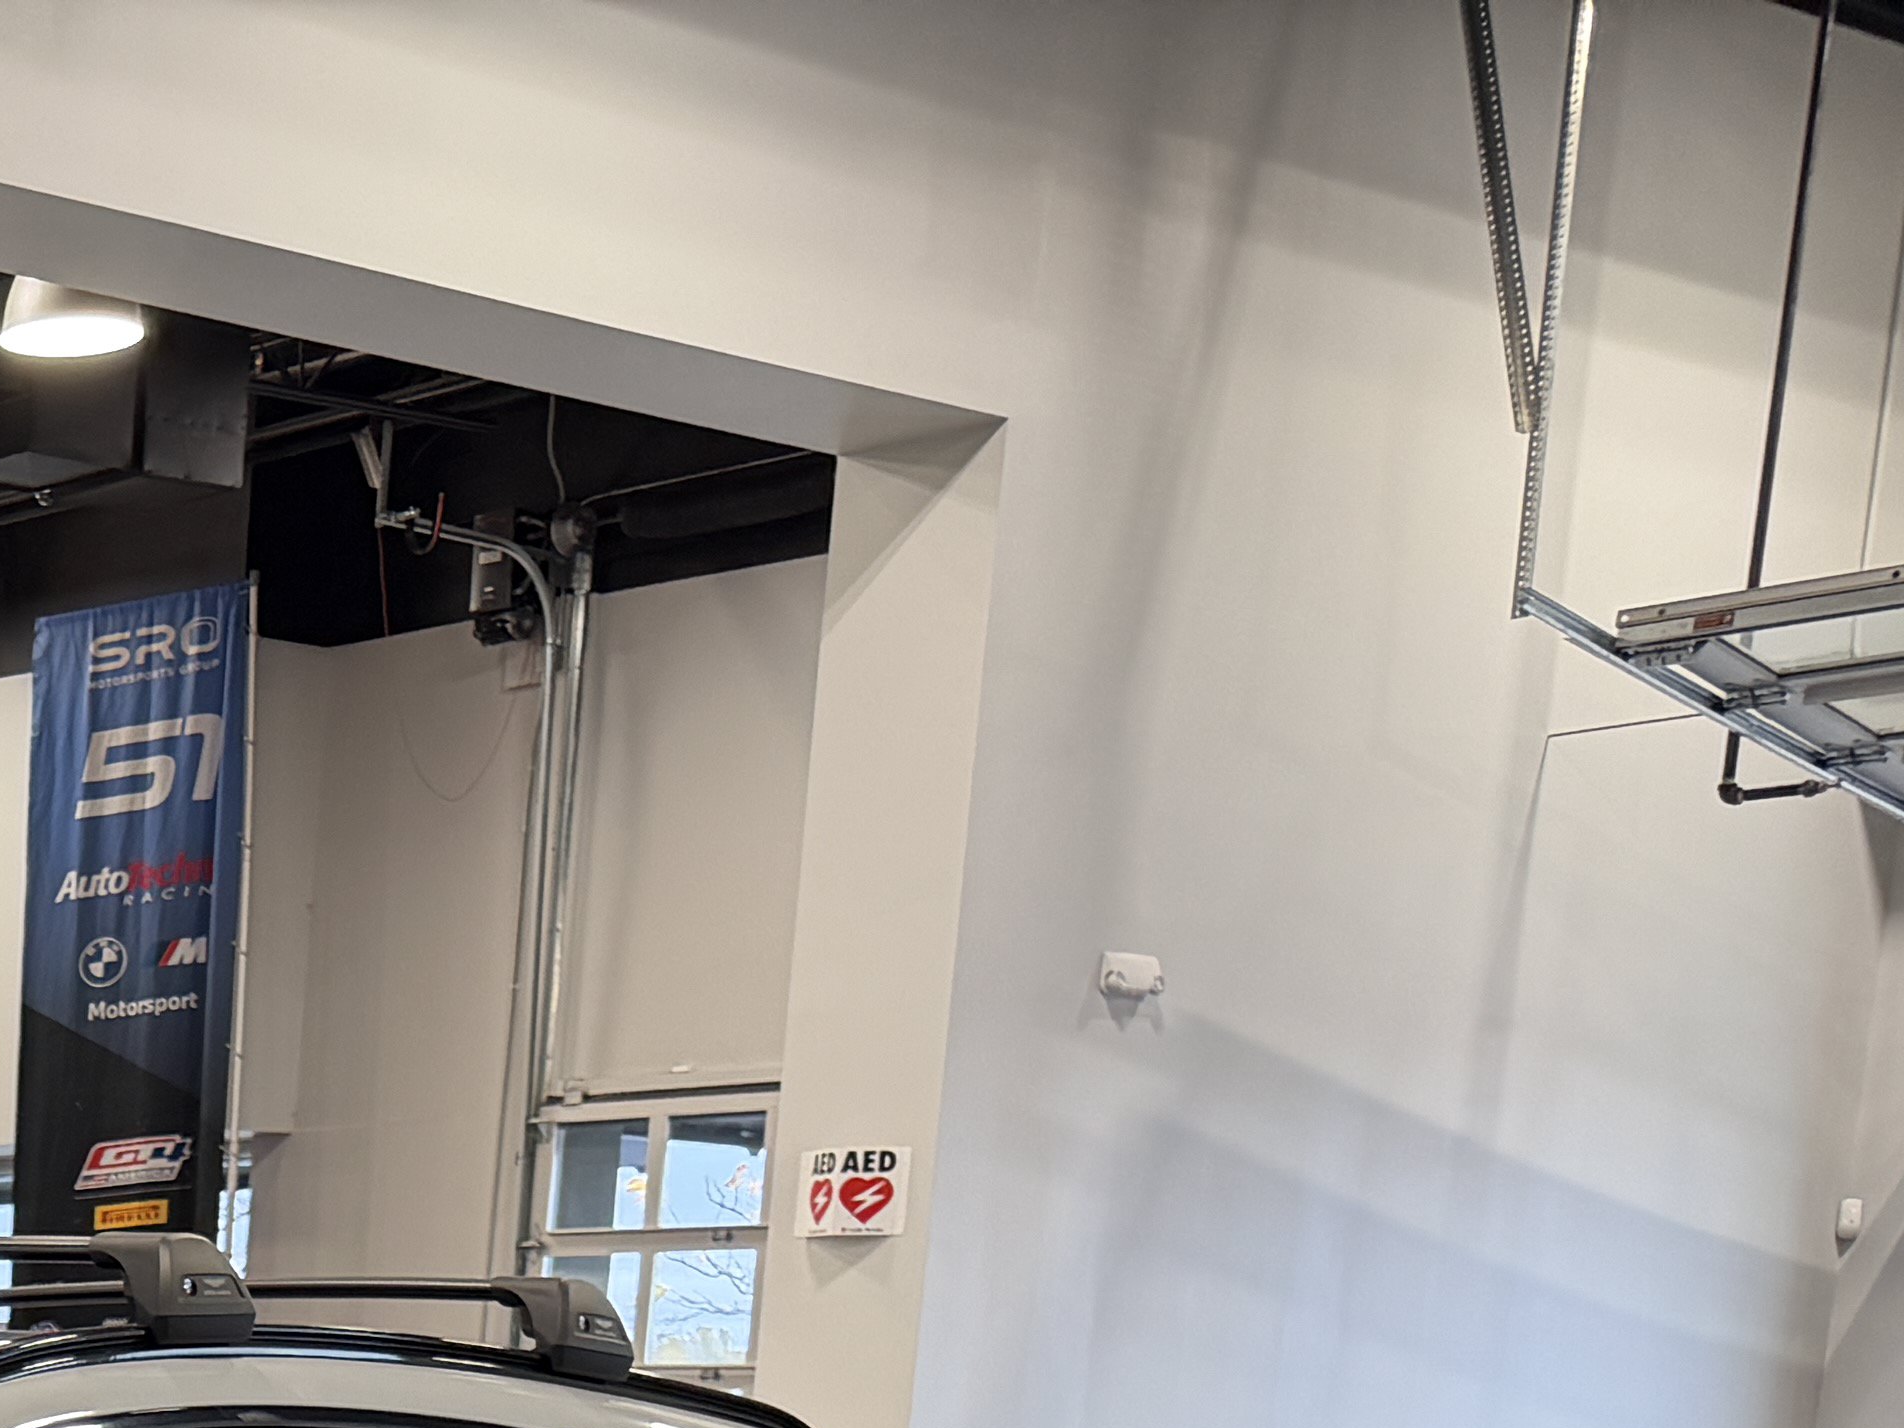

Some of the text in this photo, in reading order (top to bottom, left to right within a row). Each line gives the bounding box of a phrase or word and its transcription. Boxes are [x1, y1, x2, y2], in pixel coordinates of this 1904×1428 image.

[90, 616, 221, 673] SRO
[75, 713, 224, 820] 51
[88, 992, 199, 1021] Motorsport
[840, 1151, 897, 1173] AED
